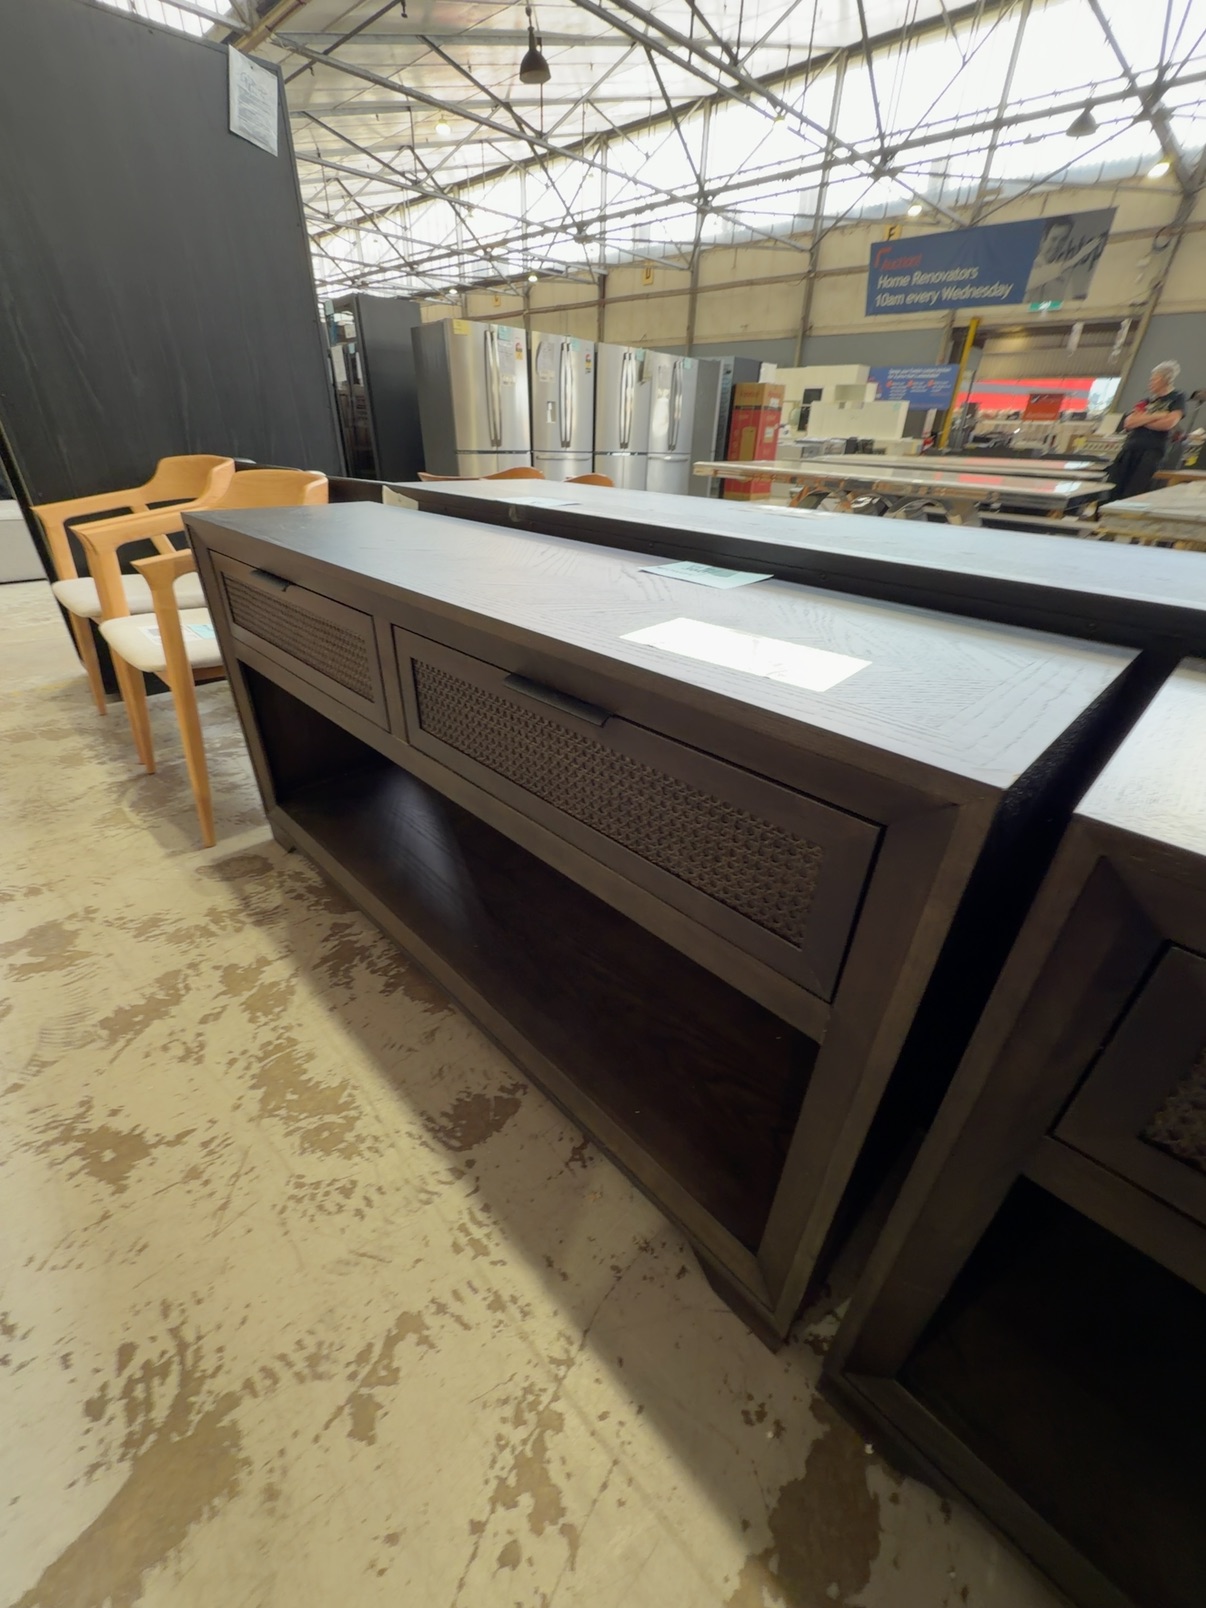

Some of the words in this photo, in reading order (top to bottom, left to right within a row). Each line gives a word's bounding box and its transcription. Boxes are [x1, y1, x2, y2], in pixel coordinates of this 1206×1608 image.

[877, 274, 911, 289] Home
[911, 266, 979, 286] Renovators
[876, 292, 906, 307] 10am
[905, 290, 940, 306] every
[941, 281, 1014, 301] Wednesday
